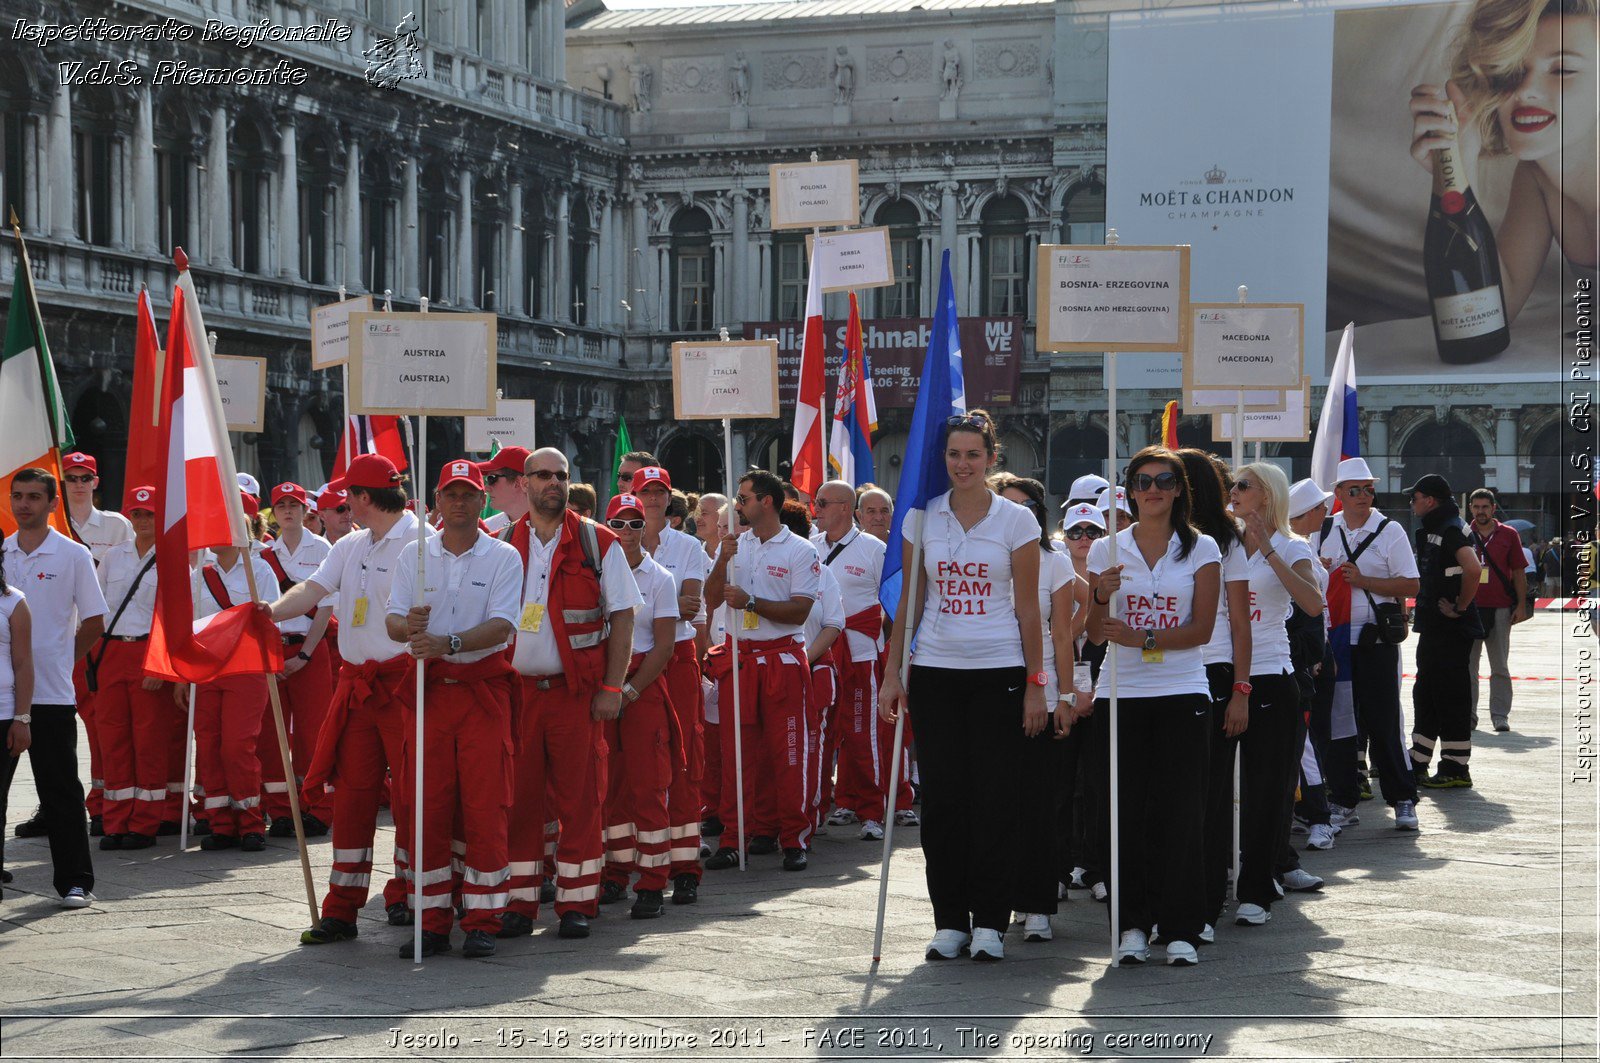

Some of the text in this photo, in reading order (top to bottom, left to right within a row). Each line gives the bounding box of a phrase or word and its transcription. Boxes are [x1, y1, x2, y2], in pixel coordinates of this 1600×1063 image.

[1140, 188, 1294, 206] MOËT & CHANDON
[1168, 209, 1264, 219] CHAMPAGNE
[1060, 281, 1169, 289] BOSNIA- ERZEGOVINA
[403, 349, 446, 357] AUSTRIA
[1218, 356, 1274, 364] (MACEDONIA)
[875, 364, 911, 376] seeing
[399, 374, 450, 384] (AUSTRIA)
[938, 561, 988, 578] FACE
[936, 580, 992, 596] TEAM
[942, 599, 986, 615] 2011
[1126, 595, 1177, 612] FACE
[1125, 612, 1179, 629] TEAM
